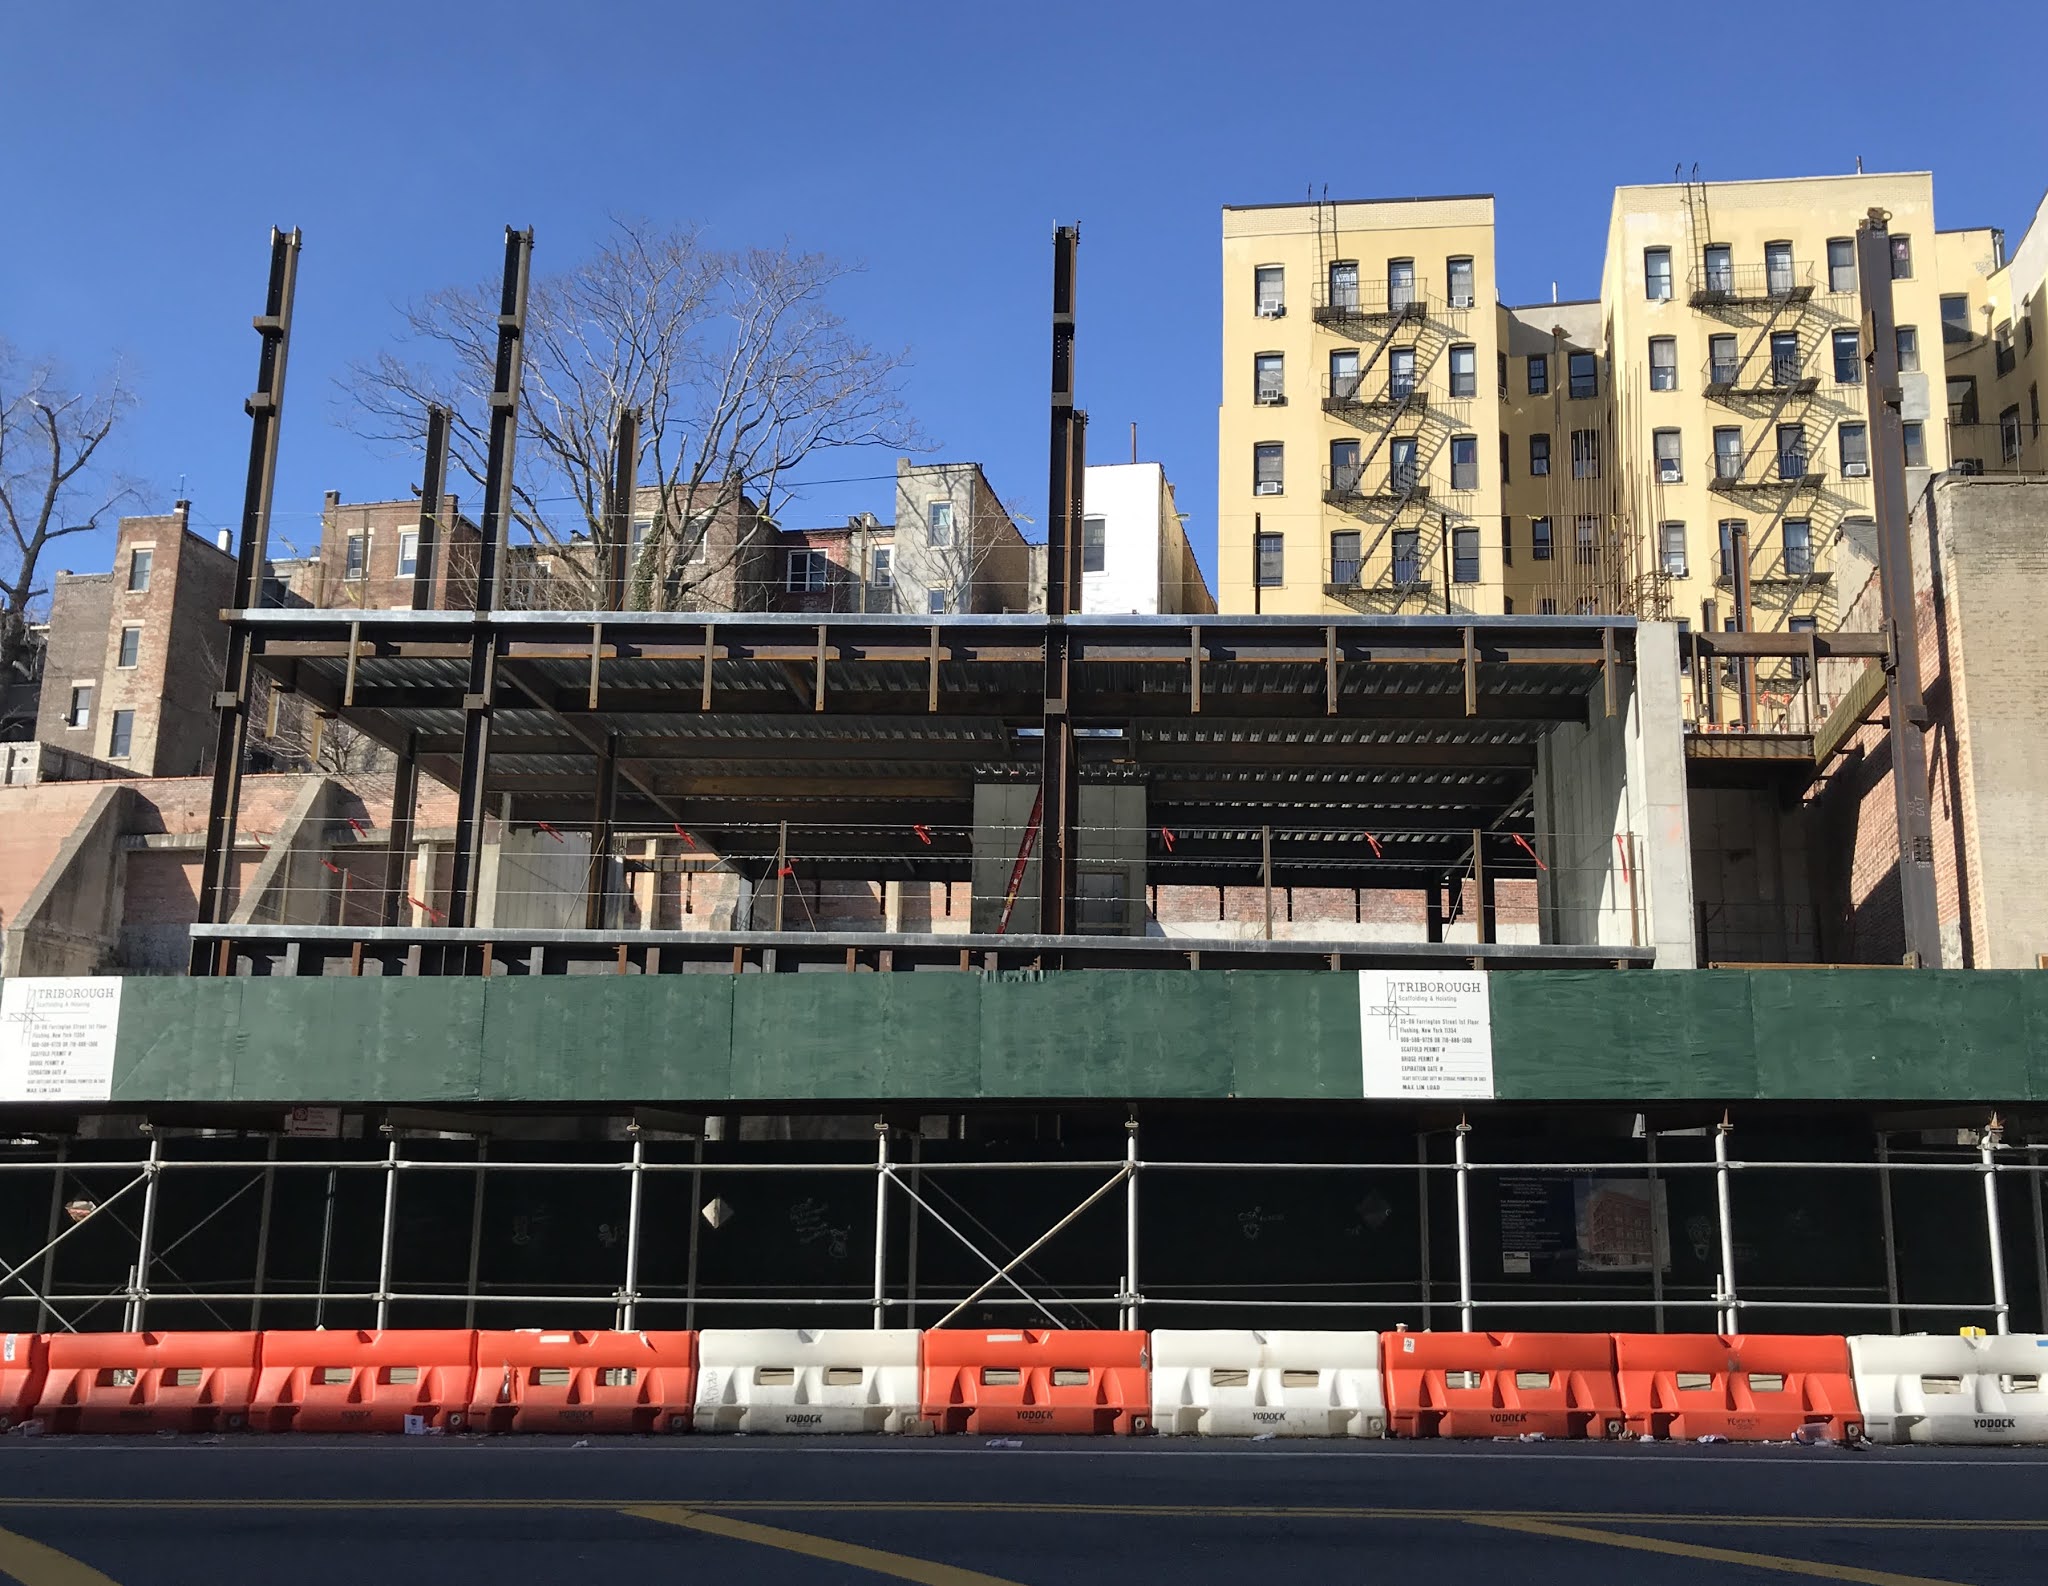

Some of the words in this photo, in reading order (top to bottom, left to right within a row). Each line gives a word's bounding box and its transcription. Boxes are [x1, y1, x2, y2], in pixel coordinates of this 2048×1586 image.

[1398, 982, 1481, 992] TRIBOROUGH
[38, 988, 114, 998] TRIBOROUGH
[785, 1414, 823, 1423] YODOCK
[1016, 1410, 1053, 1419] YODOCK
[1252, 1412, 1286, 1420] YODOCK
[1490, 1414, 1527, 1422] YODOCK
[1974, 1419, 2015, 1428] YODOCK
